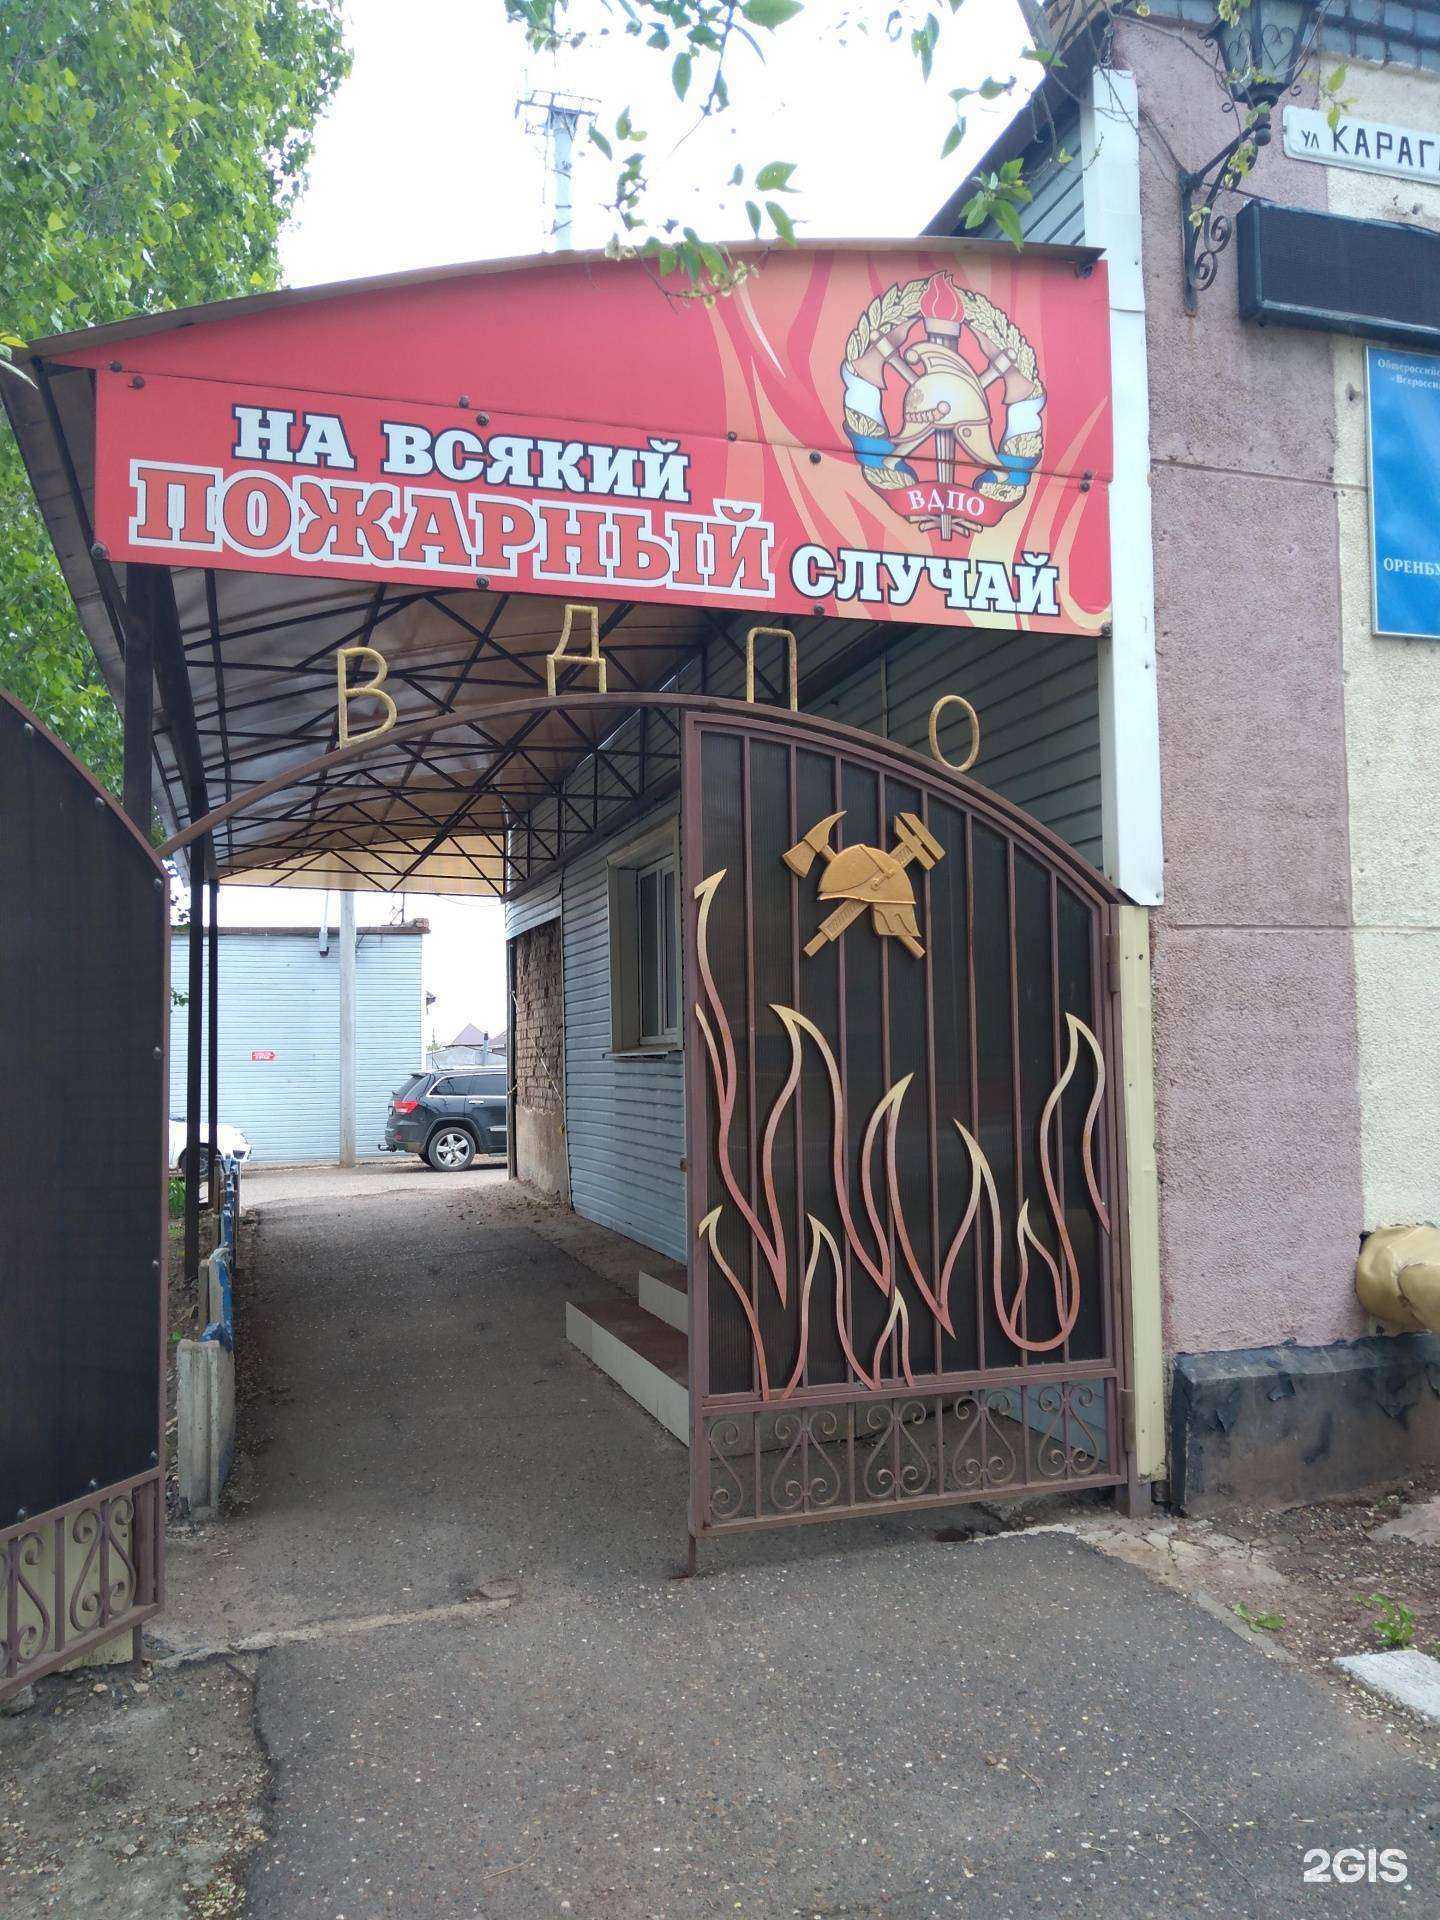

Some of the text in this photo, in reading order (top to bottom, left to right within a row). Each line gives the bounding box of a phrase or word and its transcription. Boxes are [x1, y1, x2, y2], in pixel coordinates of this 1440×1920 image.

[1332, 125, 1440, 171] КАРАГ
[232, 404, 692, 503] НА ВСЯКИЙ
[128, 459, 1061, 617] ПОЖАРНЫЙ СЛУЧАЙ
[907, 488, 985, 516] ВДПО
